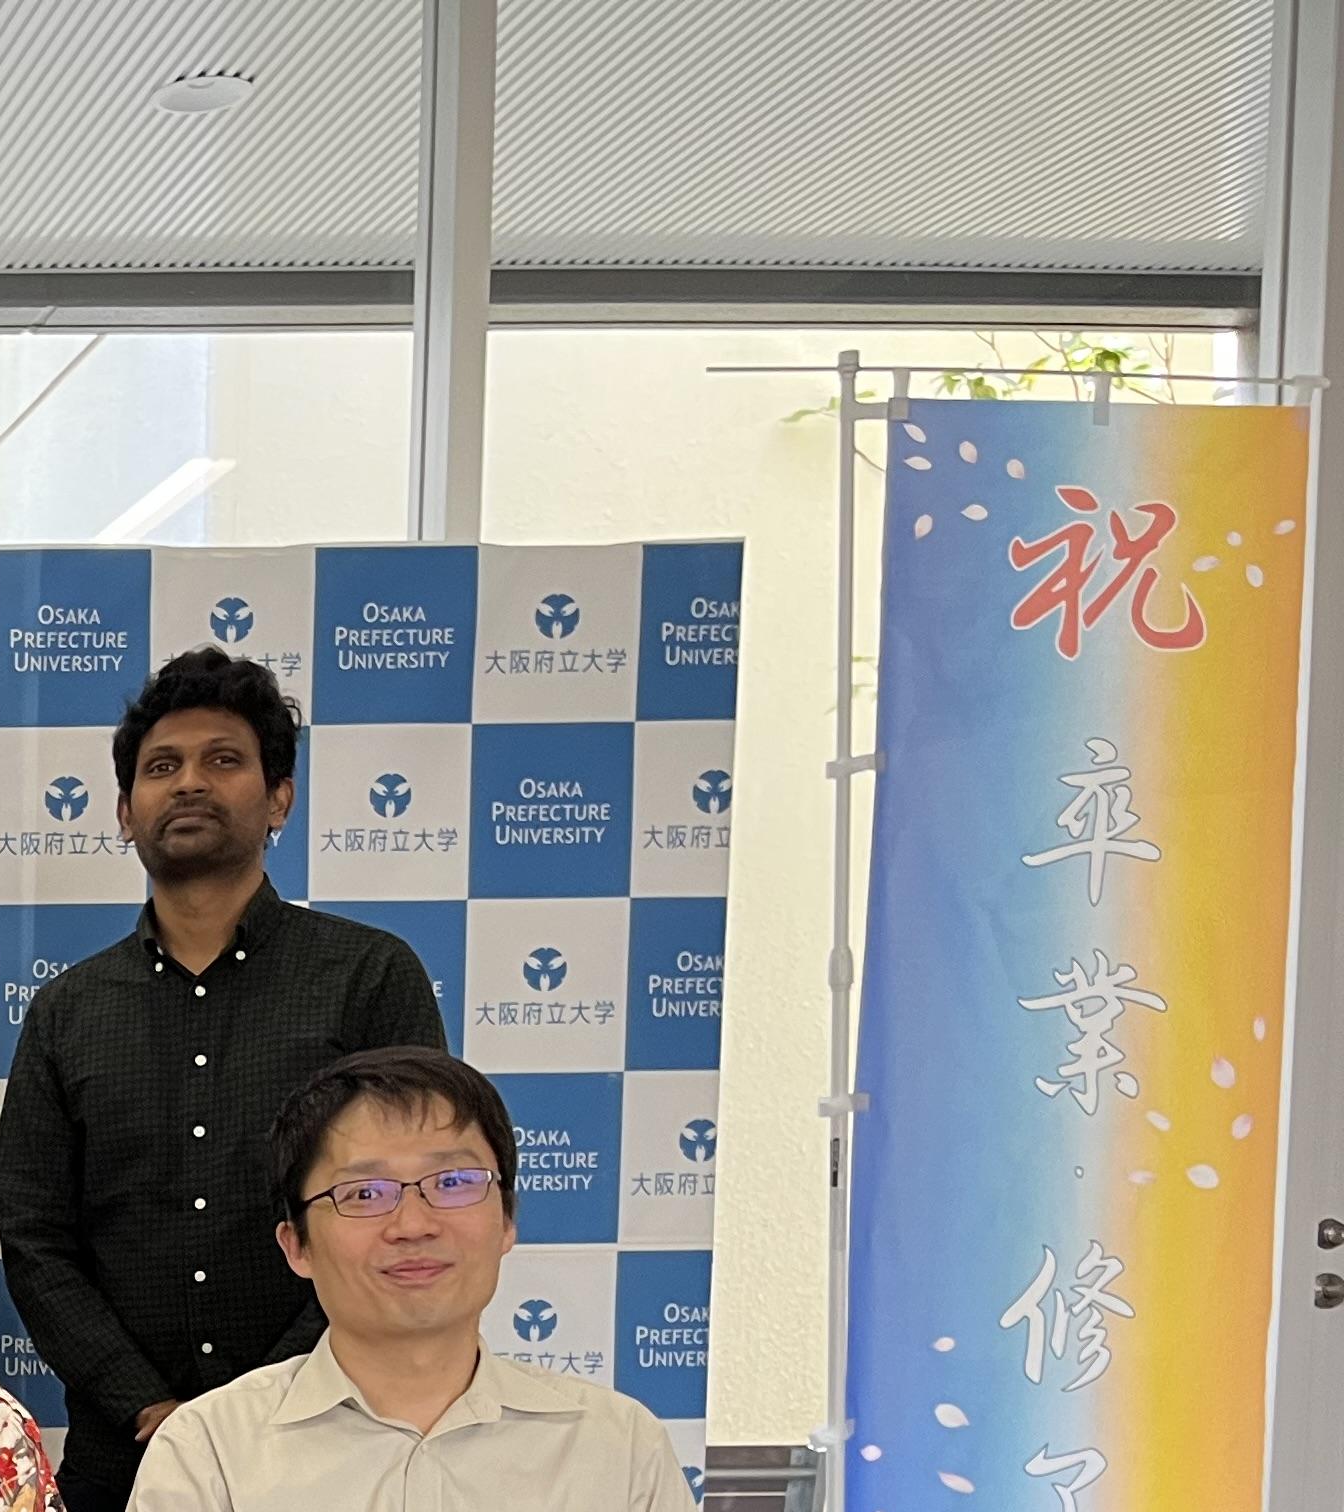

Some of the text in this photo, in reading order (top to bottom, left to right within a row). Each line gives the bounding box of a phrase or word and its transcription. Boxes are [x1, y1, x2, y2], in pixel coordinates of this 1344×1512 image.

[1008, 485, 1206, 660] 祝
[38, 605, 100, 624] OSAKA
[363, 603, 425, 622] OSAKA
[691, 597, 740, 618] OSAK
[10, 629, 127, 650] PREFECTURE
[335, 627, 454, 646] PREFECTURE
[662, 622, 738, 642] PREFEC
[15, 652, 122, 671] UNIVERSITY
[339, 650, 449, 669] UNIVERSITY
[485, 649, 626, 673] 大阪府立大学
[666, 646, 739, 666] UNIVER
[520, 779, 582, 798] OSAKA
[492, 802, 610, 821] PREFECTURE
[321, 828, 457, 852] 大阪府立大学
[496, 825, 605, 844] UNIVERSITY
[644, 825, 730, 849] 大阪府立
[677, 951, 724, 971] OSAK
[649, 975, 723, 994] PREFEC
[476, 1001, 615, 1025] 大阪府立大学
[653, 998, 721, 1017] UNIVER
[517, 1152, 598, 1169] FECTURE
[514, 1174, 592, 1191] IVERSITY
[632, 1172, 715, 1196] 大阪府立
[664, 1303, 709, 1323] OSAK
[636, 1326, 709, 1345] PREFEC
[639, 1349, 706, 1368] UNIVER
